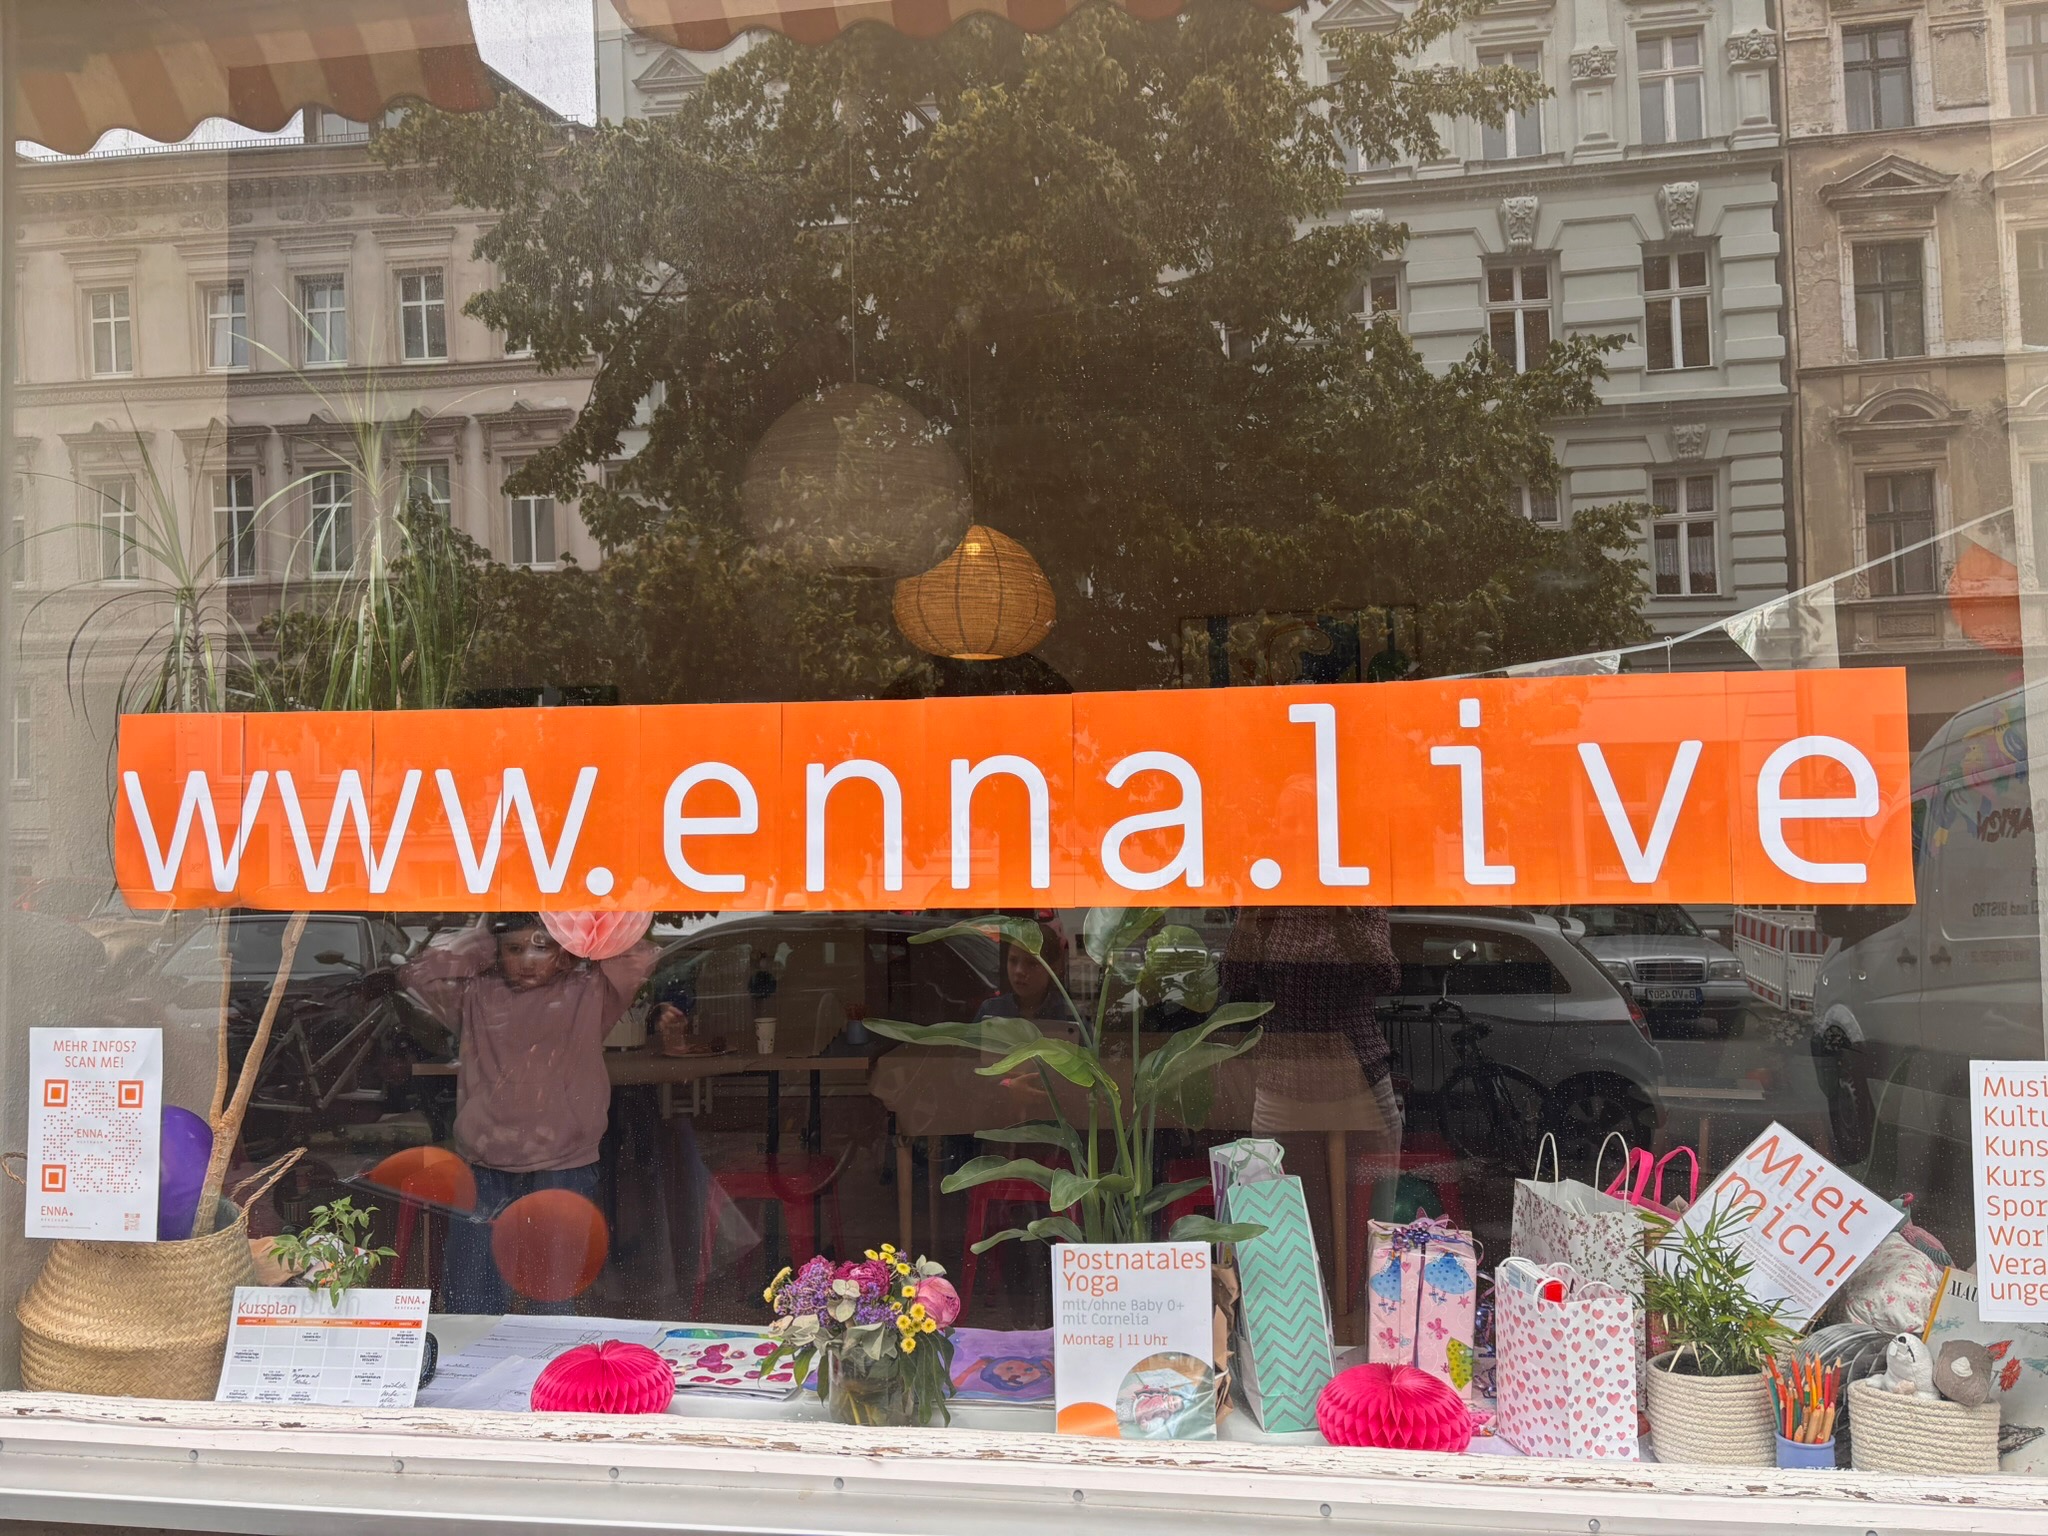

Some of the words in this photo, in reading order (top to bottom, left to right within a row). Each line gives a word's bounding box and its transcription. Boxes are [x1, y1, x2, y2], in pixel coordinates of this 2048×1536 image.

[123, 697, 1880, 896] www.enna.live
[53, 1040, 88, 1052] MEHR
[92, 1040, 136, 1052] INFOS?
[64, 1056, 96, 1068] SCAN
[100, 1056, 124, 1068] ME!
[1984, 1105, 2048, 1126] Kultu
[76, 1128, 108, 1138] ENNA.
[1986, 1136, 2048, 1157] Kuns
[1746, 1134, 1868, 1236] Miet
[1986, 1166, 2046, 1186] Kurs
[41, 1206, 74, 1216] ENNA.
[1986, 1195, 2048, 1221] Spor
[1714, 1172, 1857, 1287] mich!
[1988, 1225, 2048, 1246] Wor
[1063, 1248, 1206, 1270] Postnatales
[1989, 1254, 2046, 1276] Vera
[1062, 1272, 1120, 1296] Yoga
[1991, 1282, 2048, 1306] unge
[238, 1302, 296, 1317] Kursplan
[395, 1296, 425, 1304] ENNA.
[1062, 1300, 1126, 1311] mit/ohne
[1131, 1300, 1163, 1312] Baby
[1062, 1314, 1086, 1326] mit
[1092, 1313, 1149, 1326] Cornelia
[1062, 1334, 1114, 1348] Montag
[1127, 1334, 1140, 1346] 11
[1144, 1334, 1168, 1346] Uhr
